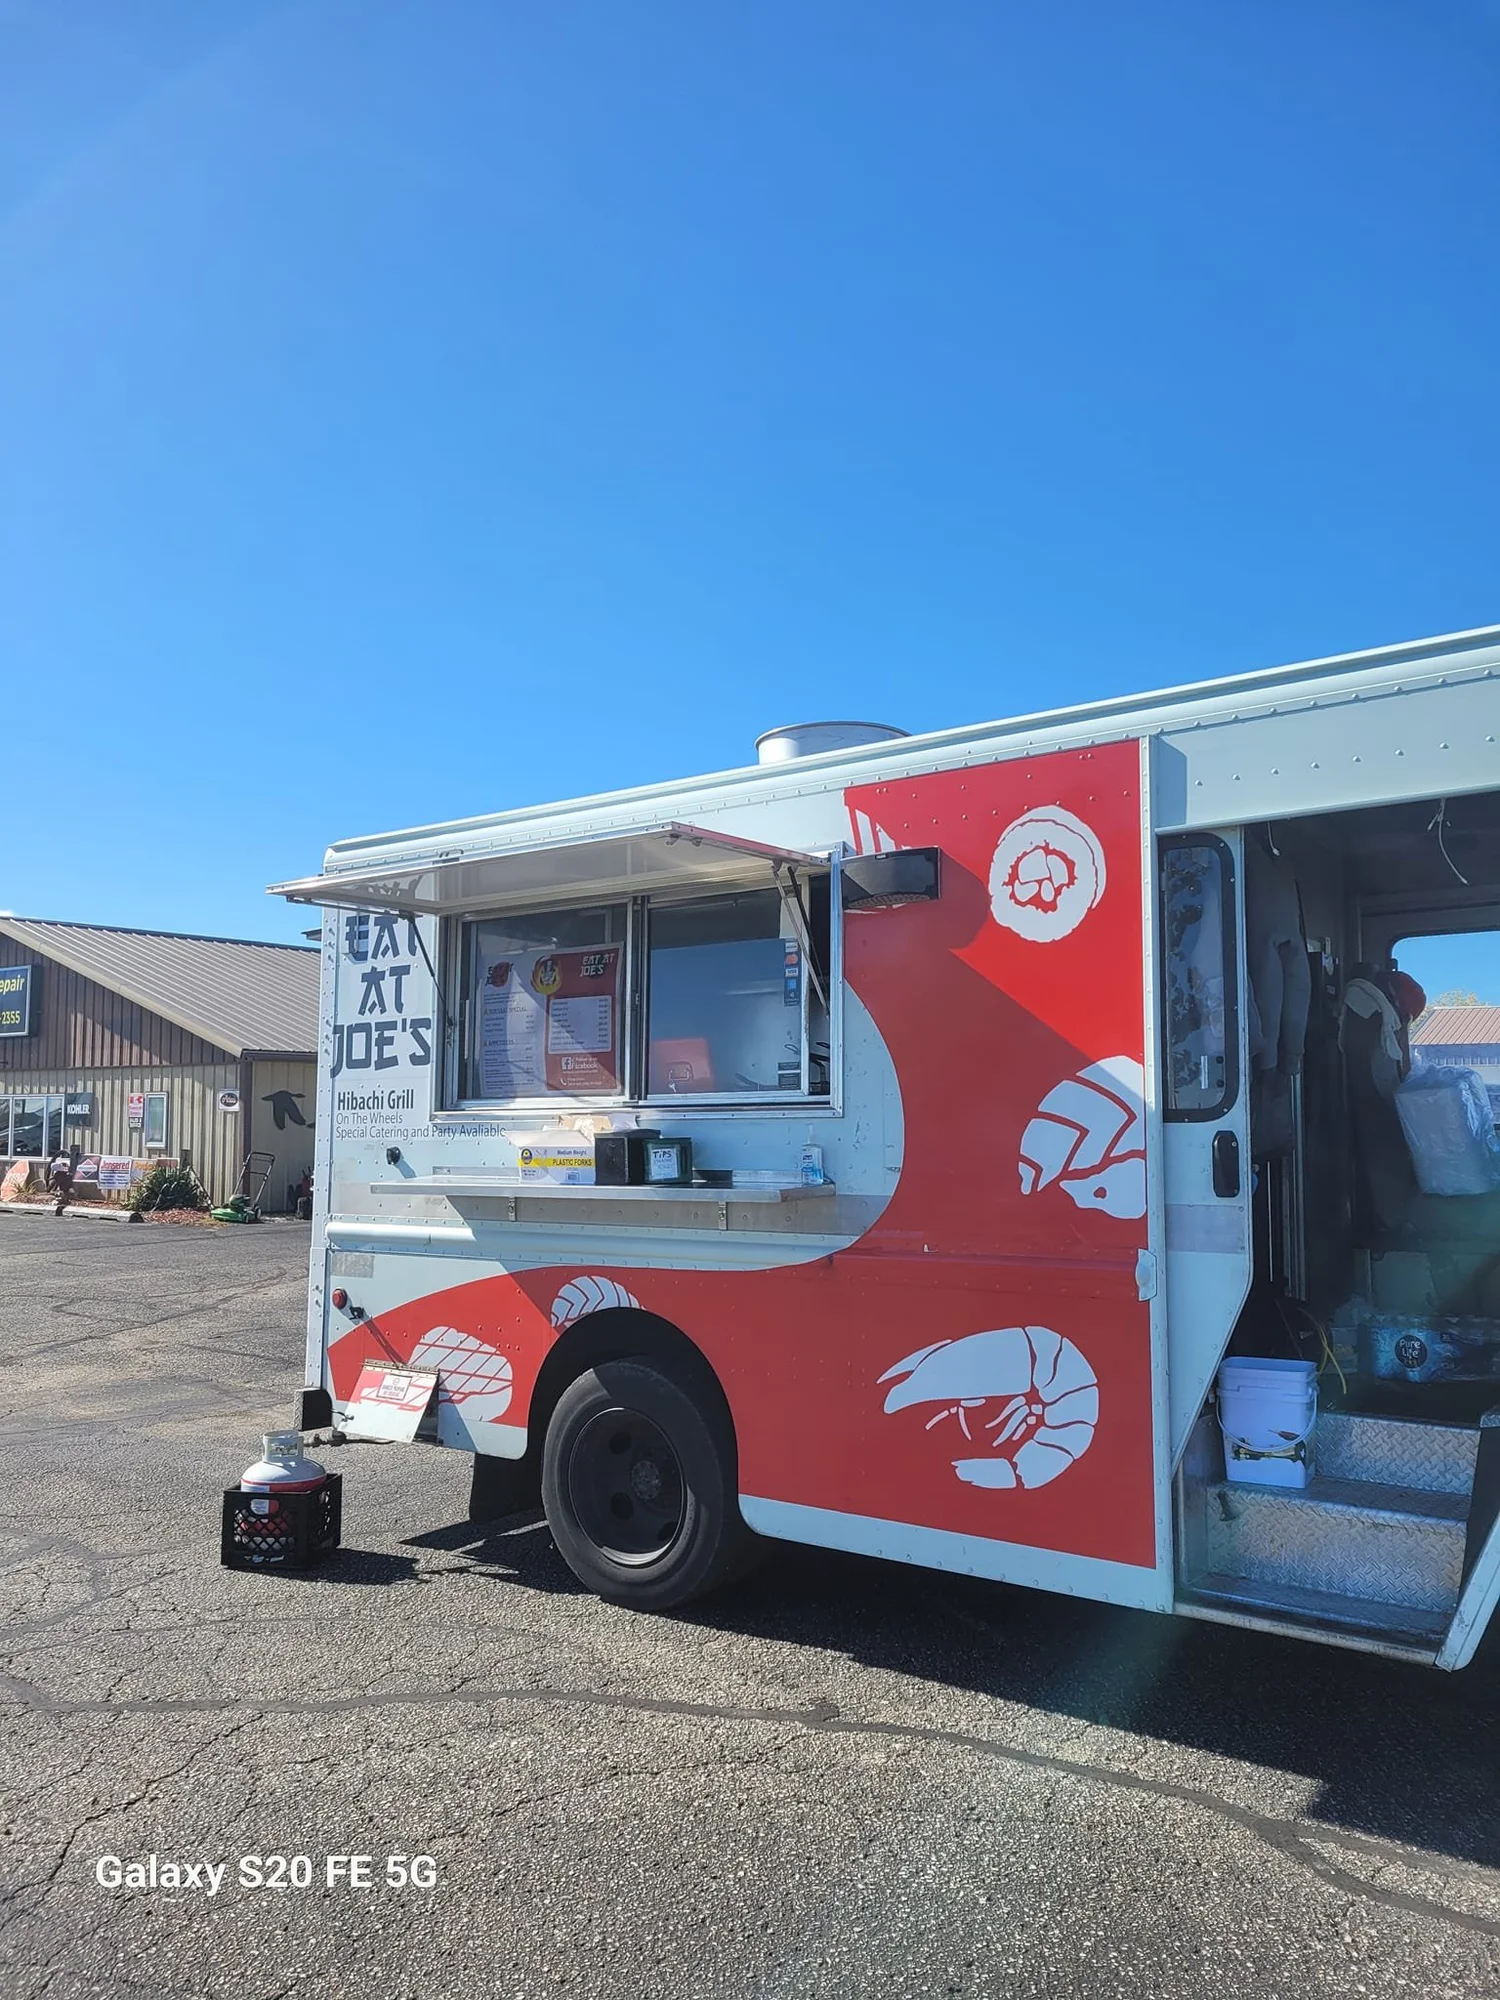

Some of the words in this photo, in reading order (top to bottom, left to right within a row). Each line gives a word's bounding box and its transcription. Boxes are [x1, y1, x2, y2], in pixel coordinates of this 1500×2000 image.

[582, 955, 600, 965] EAT
[602, 953, 615, 963] AT
[358, 965, 411, 1017] AT
[330, 1017, 432, 1079] JOE'S
[337, 1089, 384, 1111] Hibachi
[387, 1088, 415, 1110] Grill
[67, 1104, 90, 1114] KOHLER
[336, 1113, 349, 1125] On
[351, 1112, 368, 1125] The
[369, 1112, 403, 1124] Wheels
[336, 1126, 367, 1140] Special
[369, 1126, 410, 1141] Catering
[411, 1126, 429, 1138] and
[432, 1125, 456, 1141] Party
[101, 1161, 130, 1170] Jonsered
[552, 1158, 573, 1166] PLASTIC
[574, 1158, 592, 1166] FORKS
[1400, 1339, 1421, 1349] Pure
[1401, 1348, 1419, 1359] Life
